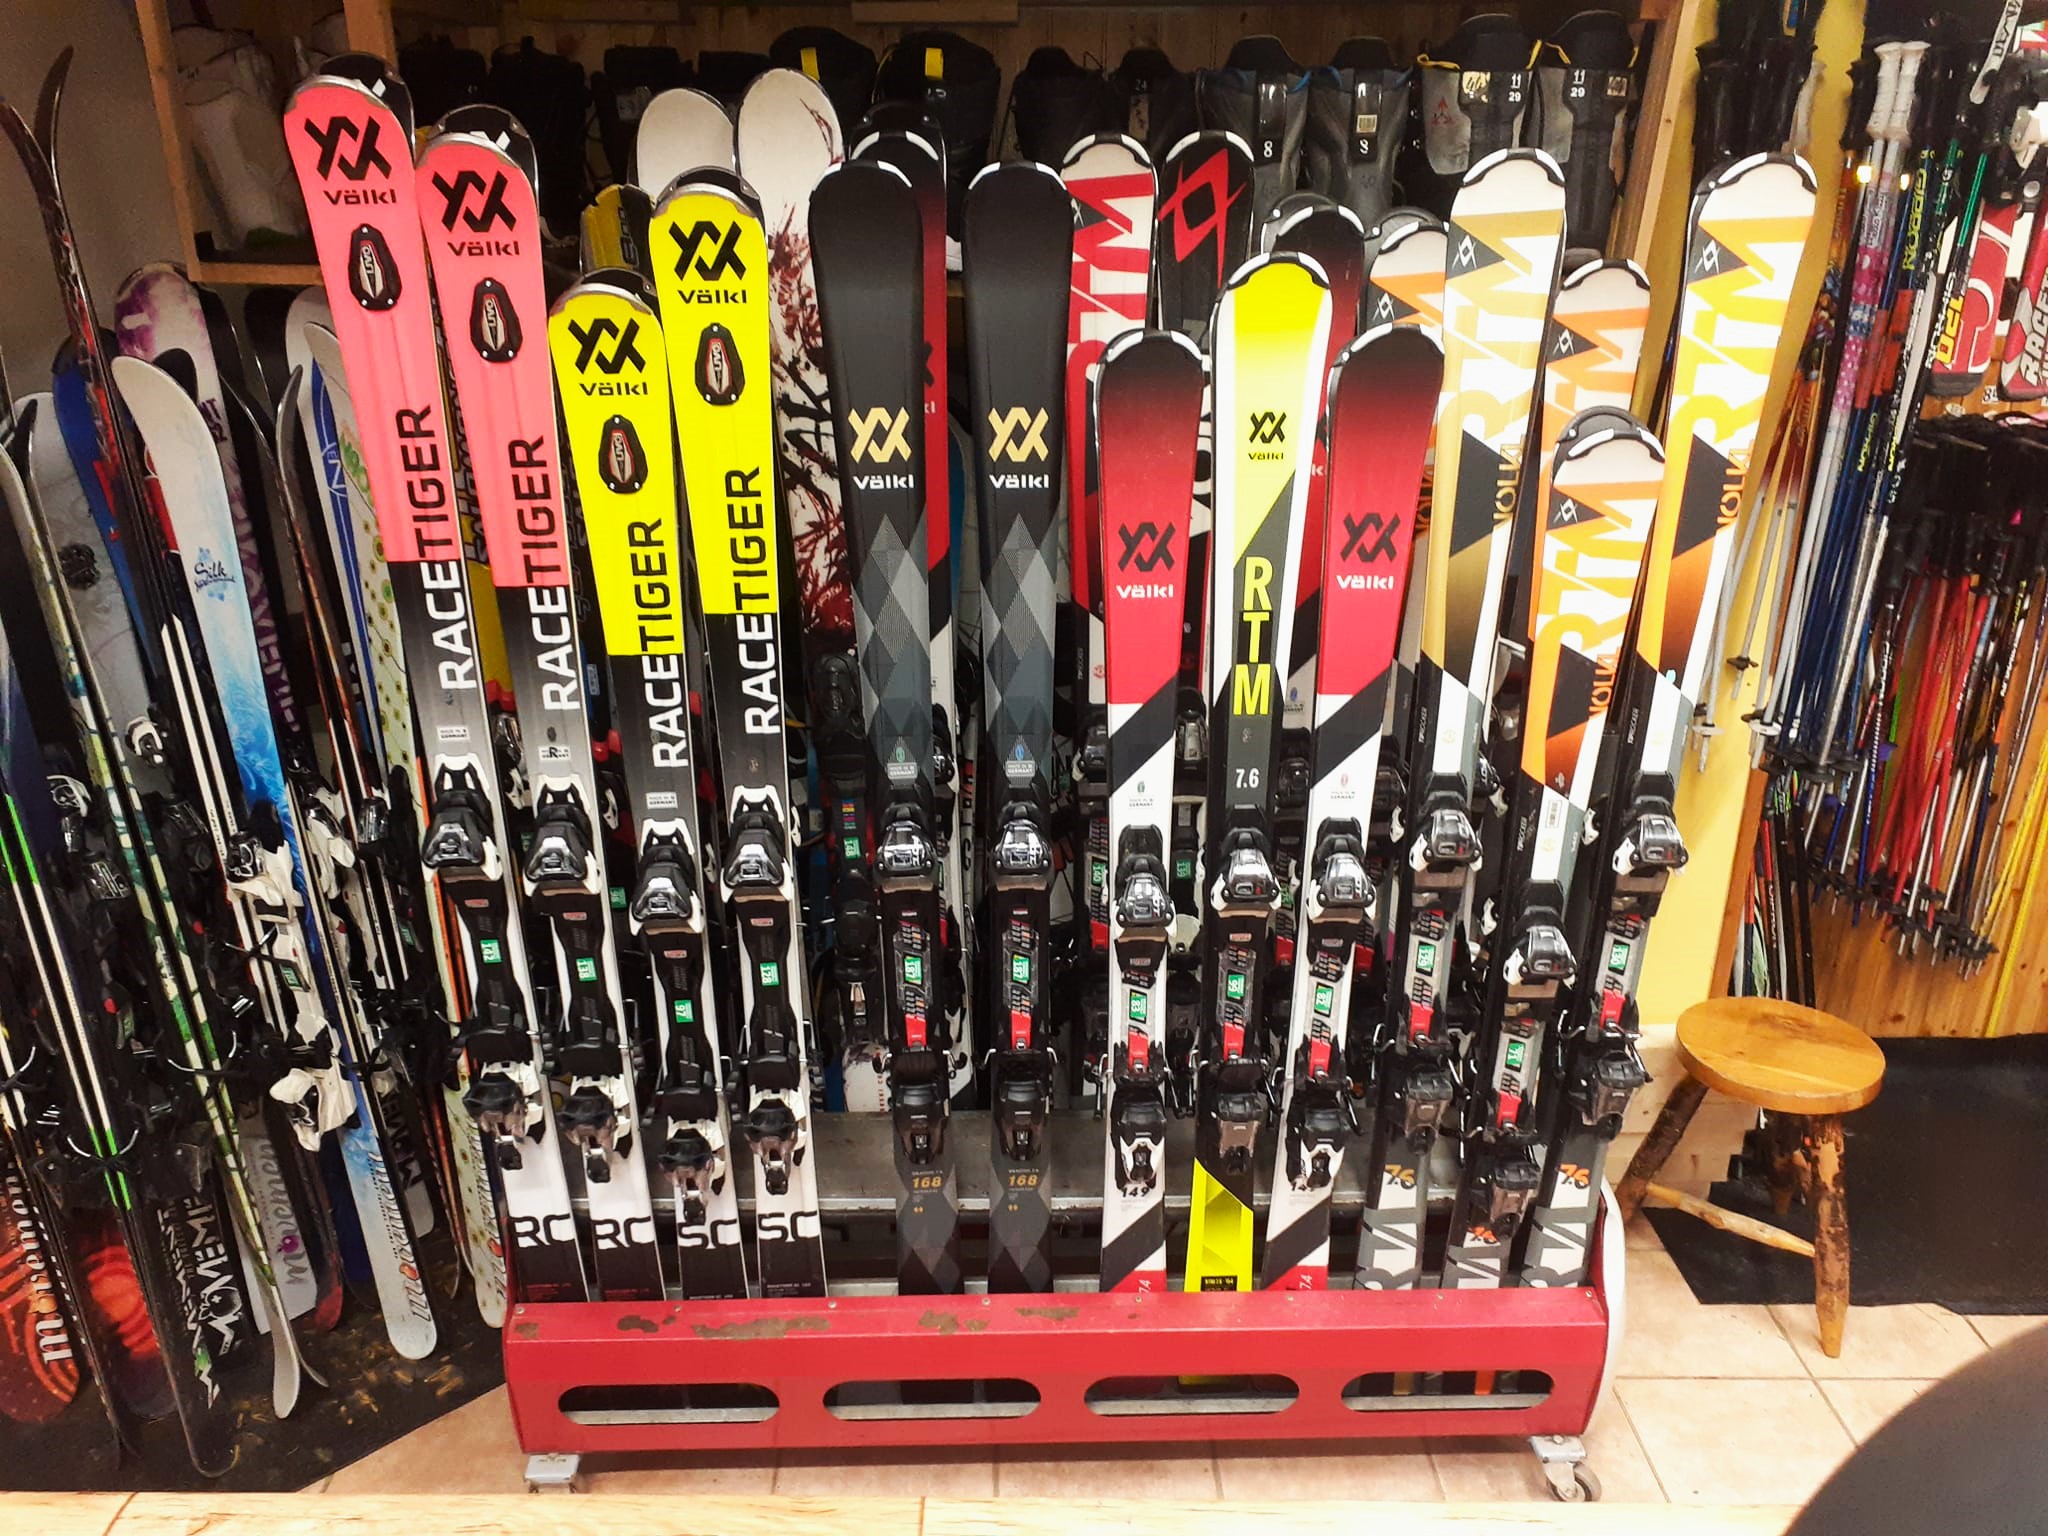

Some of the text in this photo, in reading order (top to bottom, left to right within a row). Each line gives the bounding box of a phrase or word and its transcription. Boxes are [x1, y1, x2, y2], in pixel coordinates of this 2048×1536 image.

[1508, 91, 1522, 102] 29
[1570, 86, 1586, 98] 29
[1263, 140, 1274, 158] 8
[323, 187, 397, 206] Völkl
[447, 240, 521, 257] Völkl
[676, 288, 748, 305] Völkl
[579, 380, 649, 396] Völkl
[1247, 450, 1285, 462] Völkl
[853, 473, 915, 490] Völkl
[988, 473, 1050, 490] Völkl
[194, 559, 228, 580] Silk
[1116, 583, 1175, 599] Völkl
[1336, 574, 1395, 591] Völkl
[1232, 555, 1274, 716] RTM
[1235, 767, 1260, 789] 7.6
[760, 965, 772, 983] 128
[675, 1005, 686, 1017] 97
[912, 1175, 943, 1190] 168
[1008, 1174, 1038, 1188] 168
[1121, 1185, 1151, 1198] 149
[510, 1211, 576, 1248] RC
[591, 1215, 655, 1249] RC
[758, 1211, 822, 1242] SC
